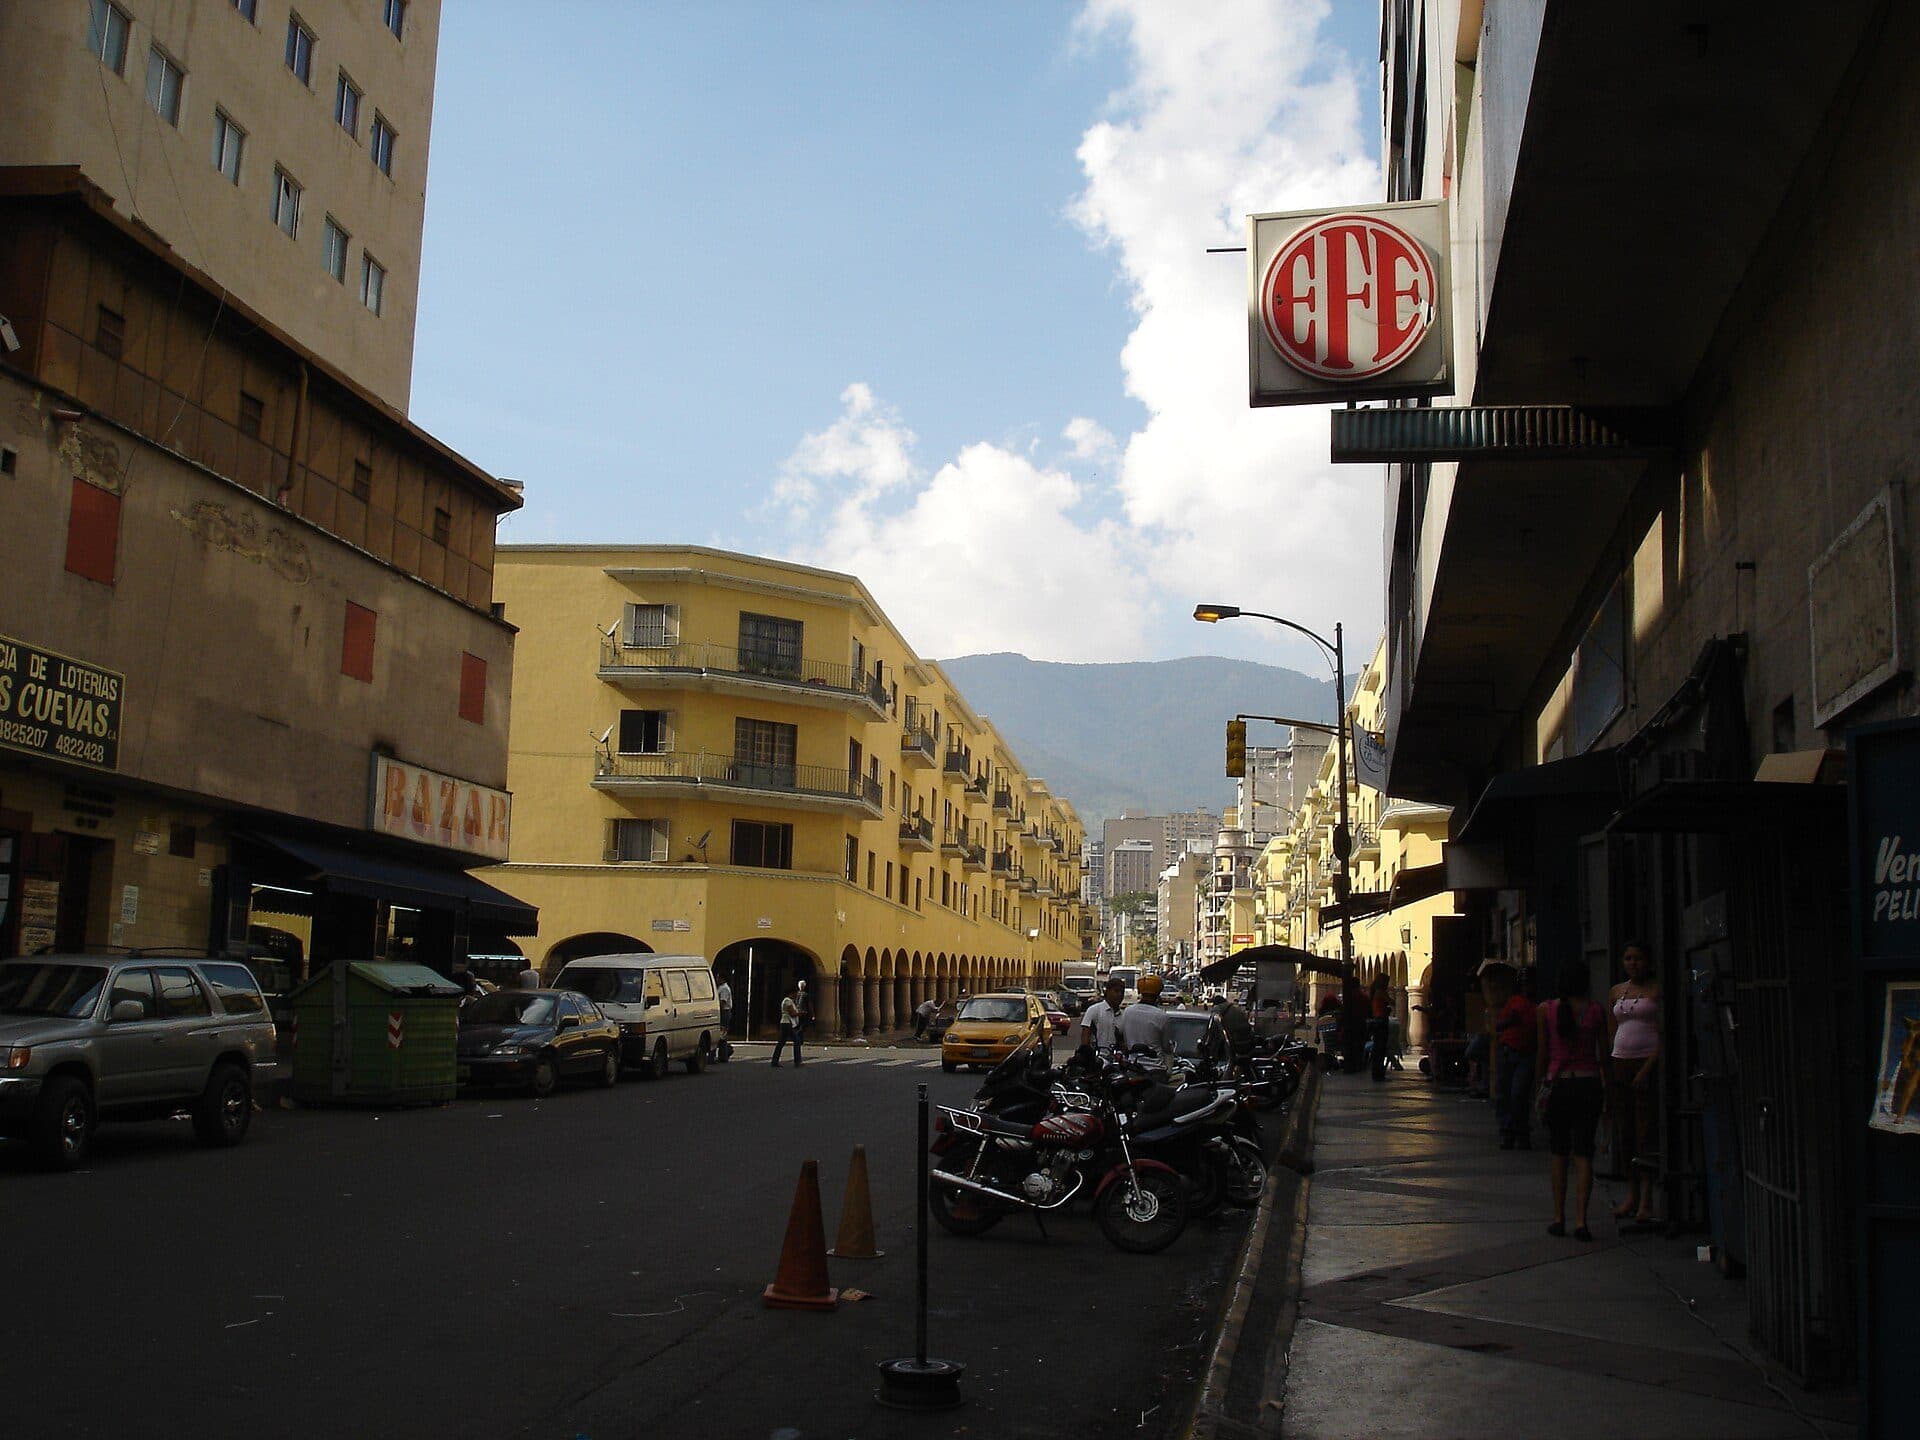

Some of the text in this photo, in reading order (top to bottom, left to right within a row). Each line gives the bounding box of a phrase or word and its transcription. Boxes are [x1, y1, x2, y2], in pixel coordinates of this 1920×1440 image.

[1272, 225, 1421, 370] EFE
[30, 653, 49, 681] DE
[60, 663, 118, 701] LOTERIAS
[18, 682, 110, 738] CUEVAS
[55, 733, 104, 763] 4822428
[384, 764, 507, 845] BAZAR
